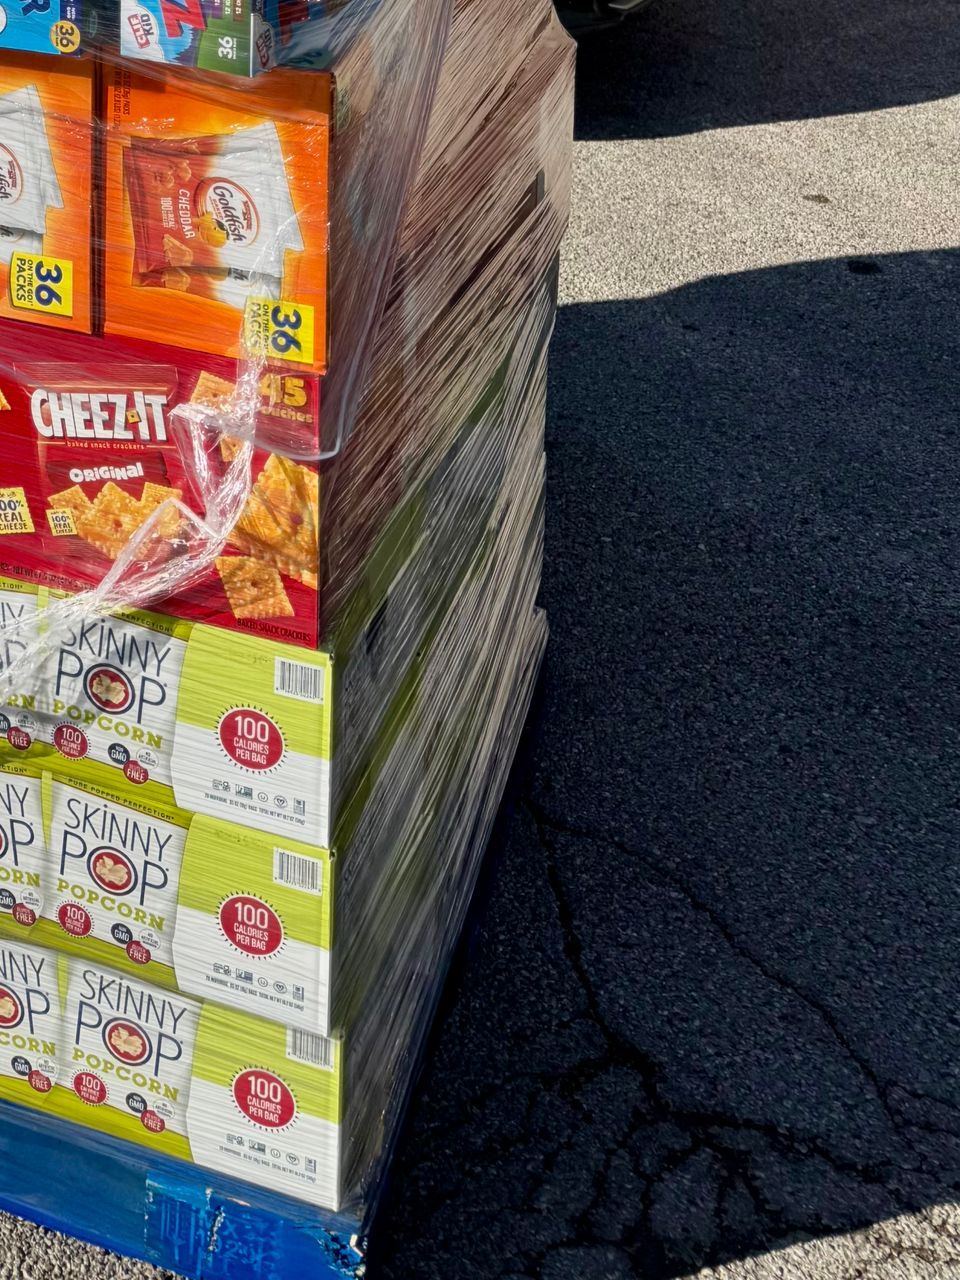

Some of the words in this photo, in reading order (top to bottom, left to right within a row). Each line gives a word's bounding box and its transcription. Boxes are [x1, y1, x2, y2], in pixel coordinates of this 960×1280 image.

[225, 7, 231, 15] 12
[235, 7, 242, 15] 12
[59, 23, 76, 49] 36
[217, 35, 234, 60] 36
[178, 188, 196, 239] CHEDDAR
[212, 185, 247, 243] Goldfish
[26, 259, 34, 272] ON
[16, 257, 27, 302] PACKS
[26, 273, 34, 288] THE
[34, 260, 63, 307] 36
[270, 305, 302, 354] 36
[257, 373, 308, 407] 45
[66, 441, 88, 449] baked
[89, 442, 111, 450] snack
[112, 442, 146, 450] crackers
[236, 618, 258, 631] BAKED
[258, 623, 280, 636] SNACK
[279, 626, 312, 643] CRACKERS
[55, 647, 167, 725] POP
[51, 697, 164, 750] POPCORN
[61, 727, 82, 744] 100
[233, 715, 270, 743] 100
[233, 737, 269, 756] CALORIES
[235, 748, 251, 763] PER
[251, 752, 267, 766] BAG
[67, 777, 86, 788] PURE
[90, 786, 120, 802] POPPED
[122, 797, 172, 820] PERFECTION
[59, 829, 169, 906] POP
[56, 877, 166, 932] POPCORN
[65, 905, 85, 923] 100
[234, 901, 269, 929] 100
[233, 922, 269, 941] CALORIES
[235, 933, 251, 948] PER
[251, 936, 267, 951] BAG
[75, 999, 183, 1077] POP
[71, 1047, 180, 1103] POPCORN
[81, 1074, 101, 1091] 100
[247, 1075, 282, 1103] 100
[247, 1095, 282, 1116] CALORIES
[249, 1105, 264, 1120] PER
[264, 1109, 279, 1124] BAG
